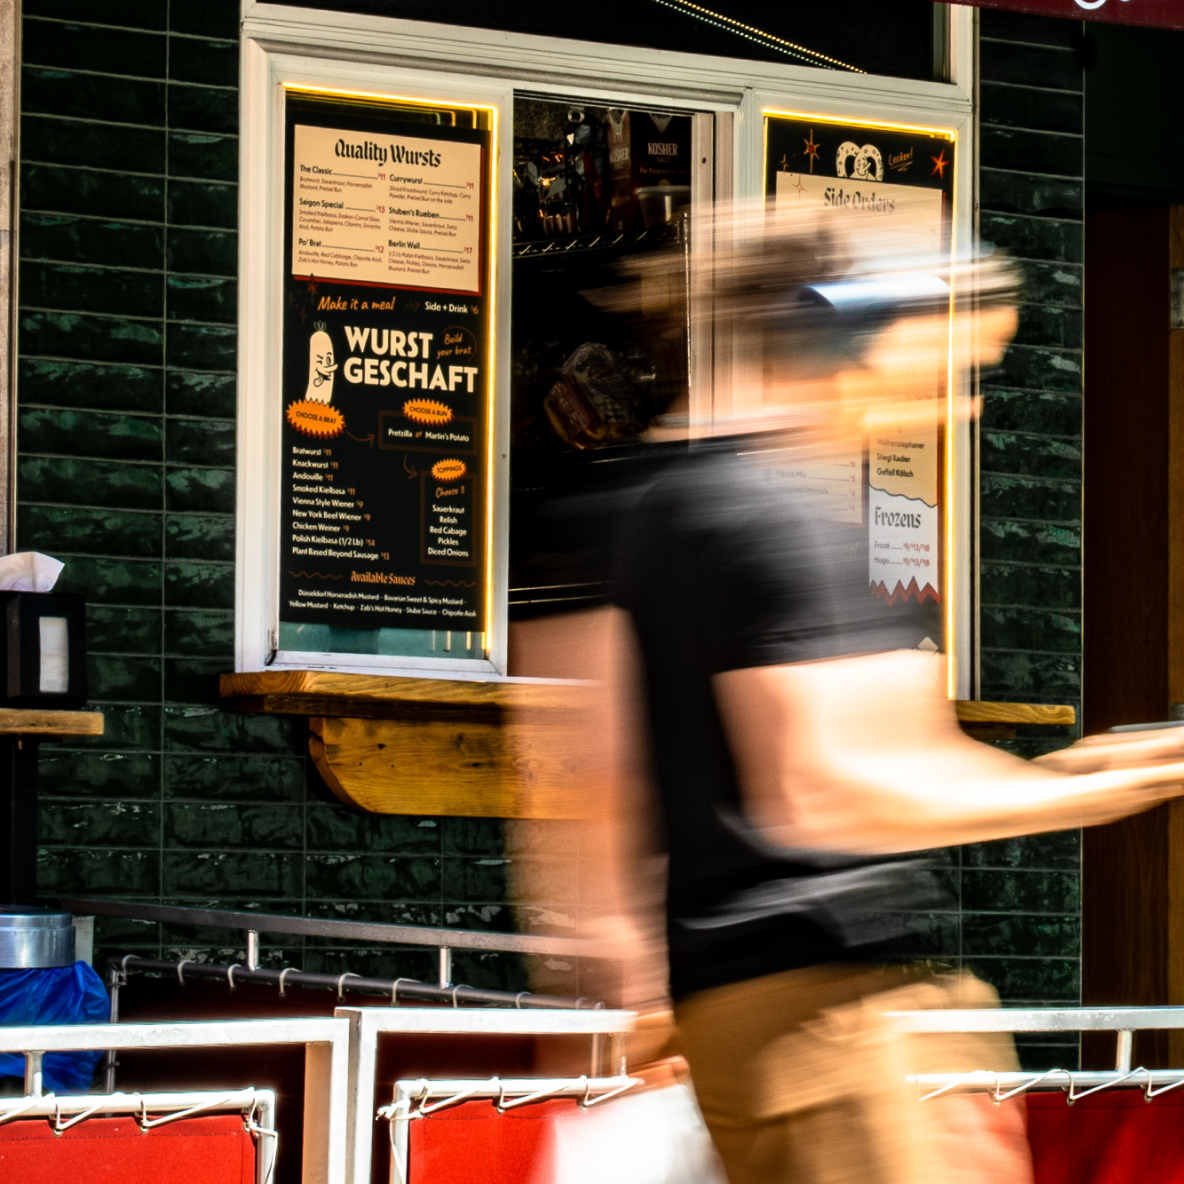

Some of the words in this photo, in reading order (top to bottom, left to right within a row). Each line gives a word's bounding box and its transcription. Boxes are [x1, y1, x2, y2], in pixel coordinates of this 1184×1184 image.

[335, 138, 387, 166] Quality
[391, 144, 441, 167] Wursts
[648, 142, 678, 156] KOSHER
[312, 166, 332, 175] Classic
[390, 174, 422, 184] Currywurst
[824, 187, 850, 208] Side
[300, 198, 320, 207] Saigon
[322, 200, 344, 209] Special
[389, 207, 414, 216] Stuben's
[416, 210, 439, 218] Rueben
[388, 240, 406, 248] Berlin
[407, 241, 420, 249] Wall
[318, 296, 347, 311] Make
[350, 296, 359, 309] it
[362, 301, 368, 310] a
[372, 296, 396, 310] meal
[425, 302, 440, 311] Side
[449, 304, 468, 313] Drink
[344, 326, 433, 359] WURST
[444, 333, 462, 344] Build
[436, 348, 452, 359] your
[455, 346, 471, 355] brat
[344, 357, 478, 393] GESCHAFT
[410, 406, 431, 415] CHOOSE
[296, 411, 317, 420] CHOOSE
[323, 415, 336, 424] BRAT
[388, 428, 412, 437] Pretzilla
[425, 432, 449, 440] Martin's
[450, 433, 470, 442] Potato
[293, 447, 321, 456] Bratwurst
[293, 459, 328, 469] Knackwurst
[437, 464, 462, 474] TOPPINGS
[292, 472, 323, 481] Andouille
[293, 484, 318, 493] Smoked
[319, 486, 346, 495] Kielbasa
[435, 487, 458, 498] Choose
[460, 486, 465, 494] 3
[293, 497, 314, 505] Vienna
[316, 498, 331, 507] Style
[332, 500, 354, 508] Wiener
[432, 504, 464, 514] Sauerkraut
[339, 512, 362, 520] Wiener
[875, 507, 921, 528] Frozens
[292, 522, 317, 530] Chicken
[318, 523, 340, 532] Weiner
[443, 527, 467, 537] Cabage
[292, 534, 310, 542] Polish
[312, 536, 338, 544] Kielbasa
[339, 537, 352, 546] (1/2
[352, 538, 363, 547] Lb)
[438, 537, 459, 546] Pickles
[292, 547, 308, 555] Plant
[309, 548, 328, 556] Based
[328, 550, 352, 558] Beyond
[353, 551, 379, 561] Sausage
[428, 547, 446, 556] Diced
[447, 548, 469, 557] Onions
[874, 556, 889, 565] Hugo
[350, 571, 387, 584] Available
[388, 574, 416, 585] Sauces
[384, 594, 406, 602] Bavarian
[289, 600, 306, 608] Yellow
[333, 603, 355, 611] Ketchup
